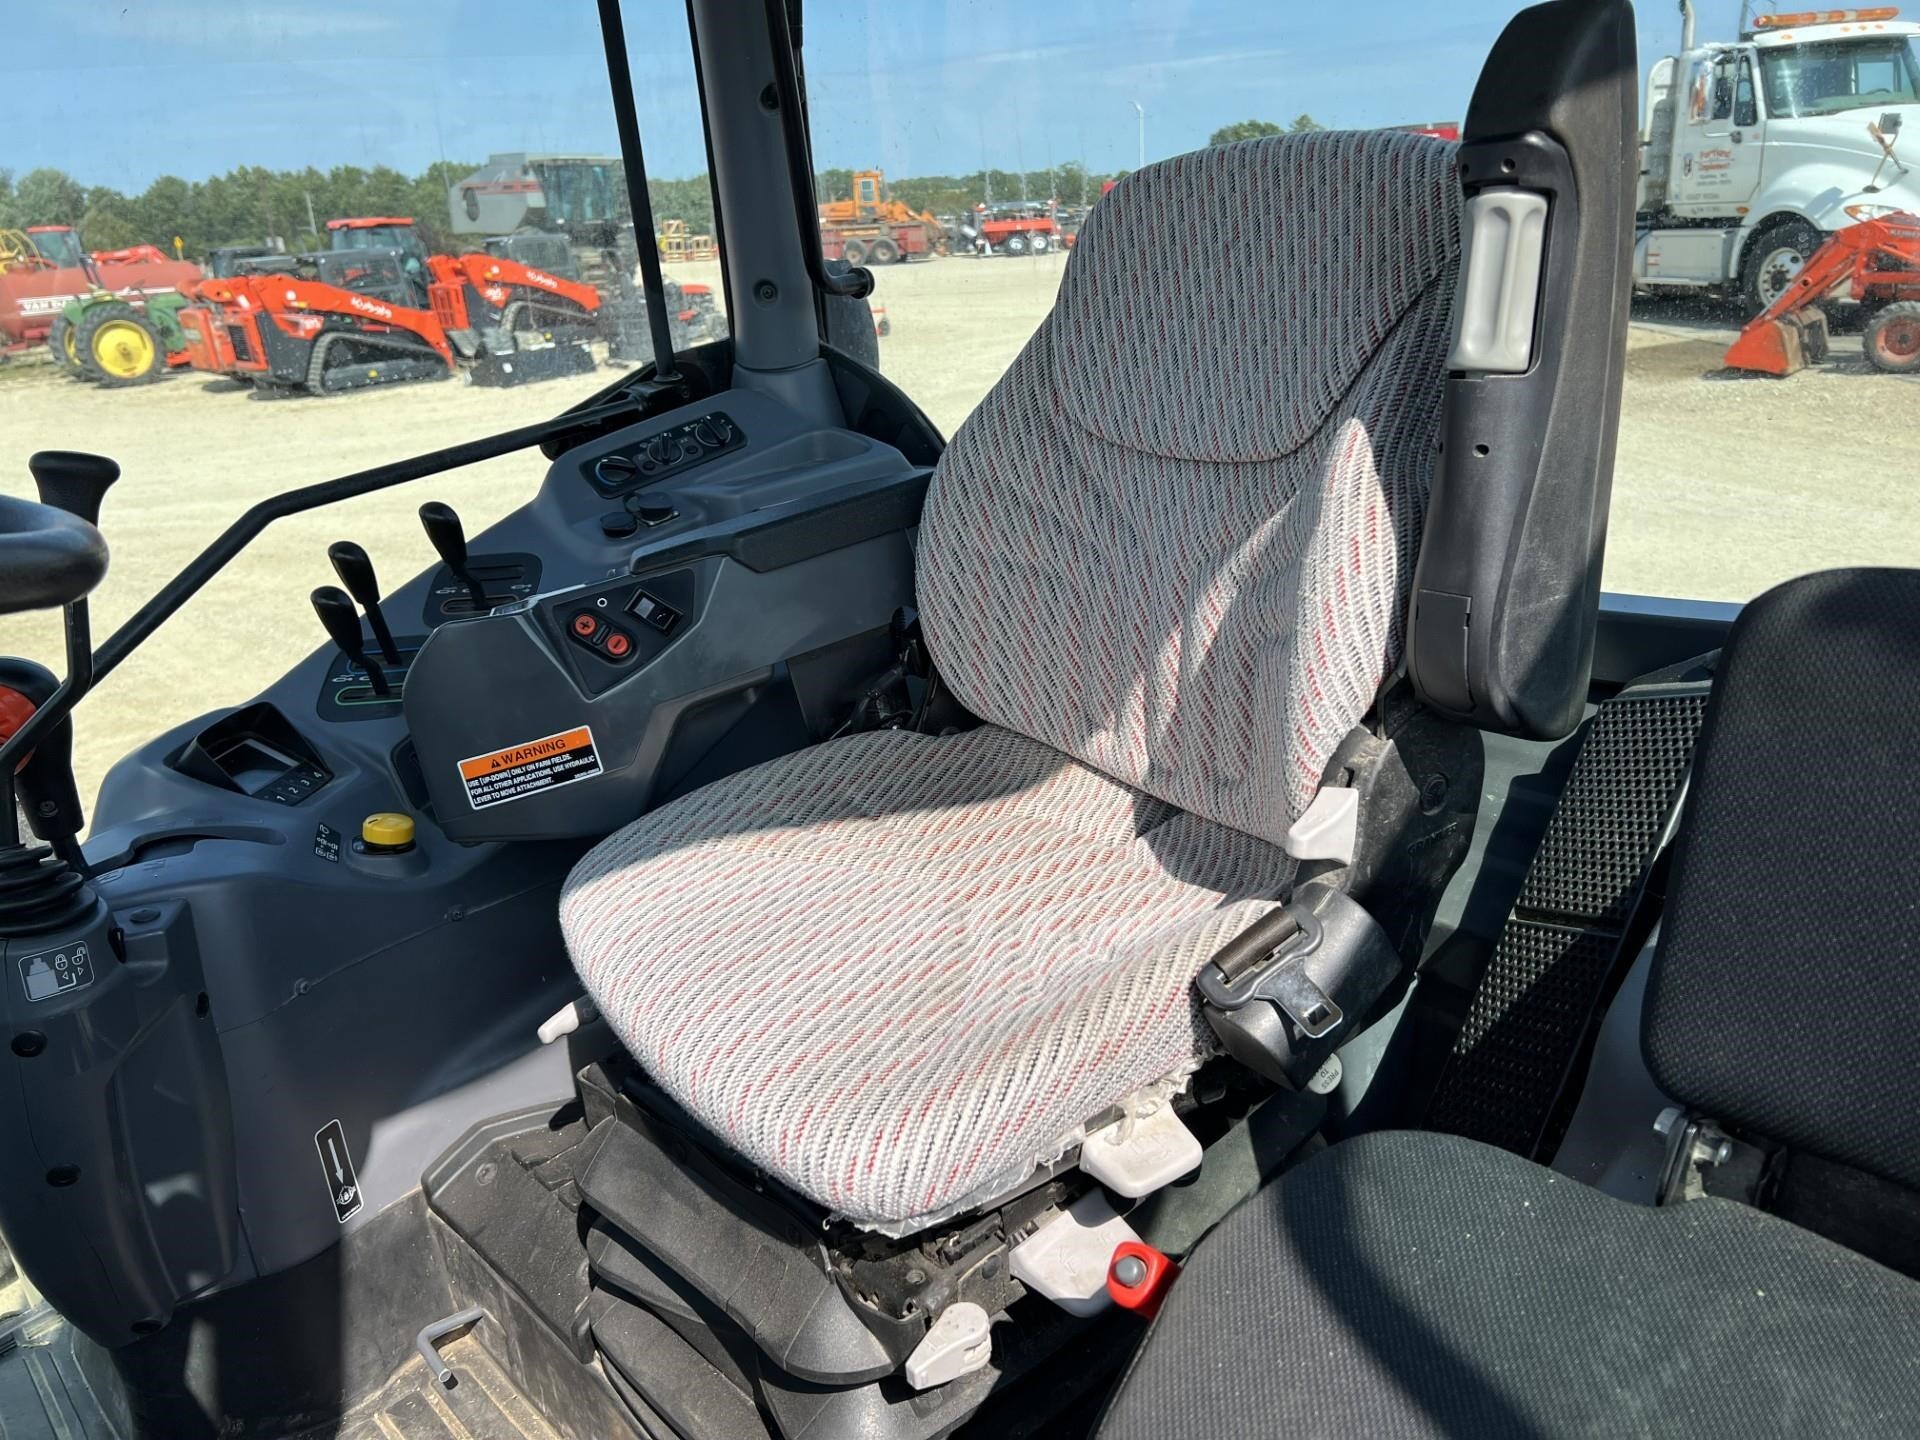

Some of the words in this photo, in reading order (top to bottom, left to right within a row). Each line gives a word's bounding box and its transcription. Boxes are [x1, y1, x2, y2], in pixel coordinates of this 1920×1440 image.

[351, 296, 393, 319] Kubota
[501, 739, 566, 765] WARNING
[468, 779, 480, 788] USE
[511, 766, 526, 776] ONLY
[535, 759, 551, 769] FARM
[471, 787, 483, 796] FOR
[483, 784, 494, 792] ALL
[493, 779, 513, 789] OTHER
[553, 764, 565, 773] USE
[564, 755, 595, 769] HYDRAULIC
[288, 786, 299, 794] 2
[474, 794, 492, 804] LEVER
[492, 791, 500, 799] TO
[500, 787, 516, 797] MOVE
